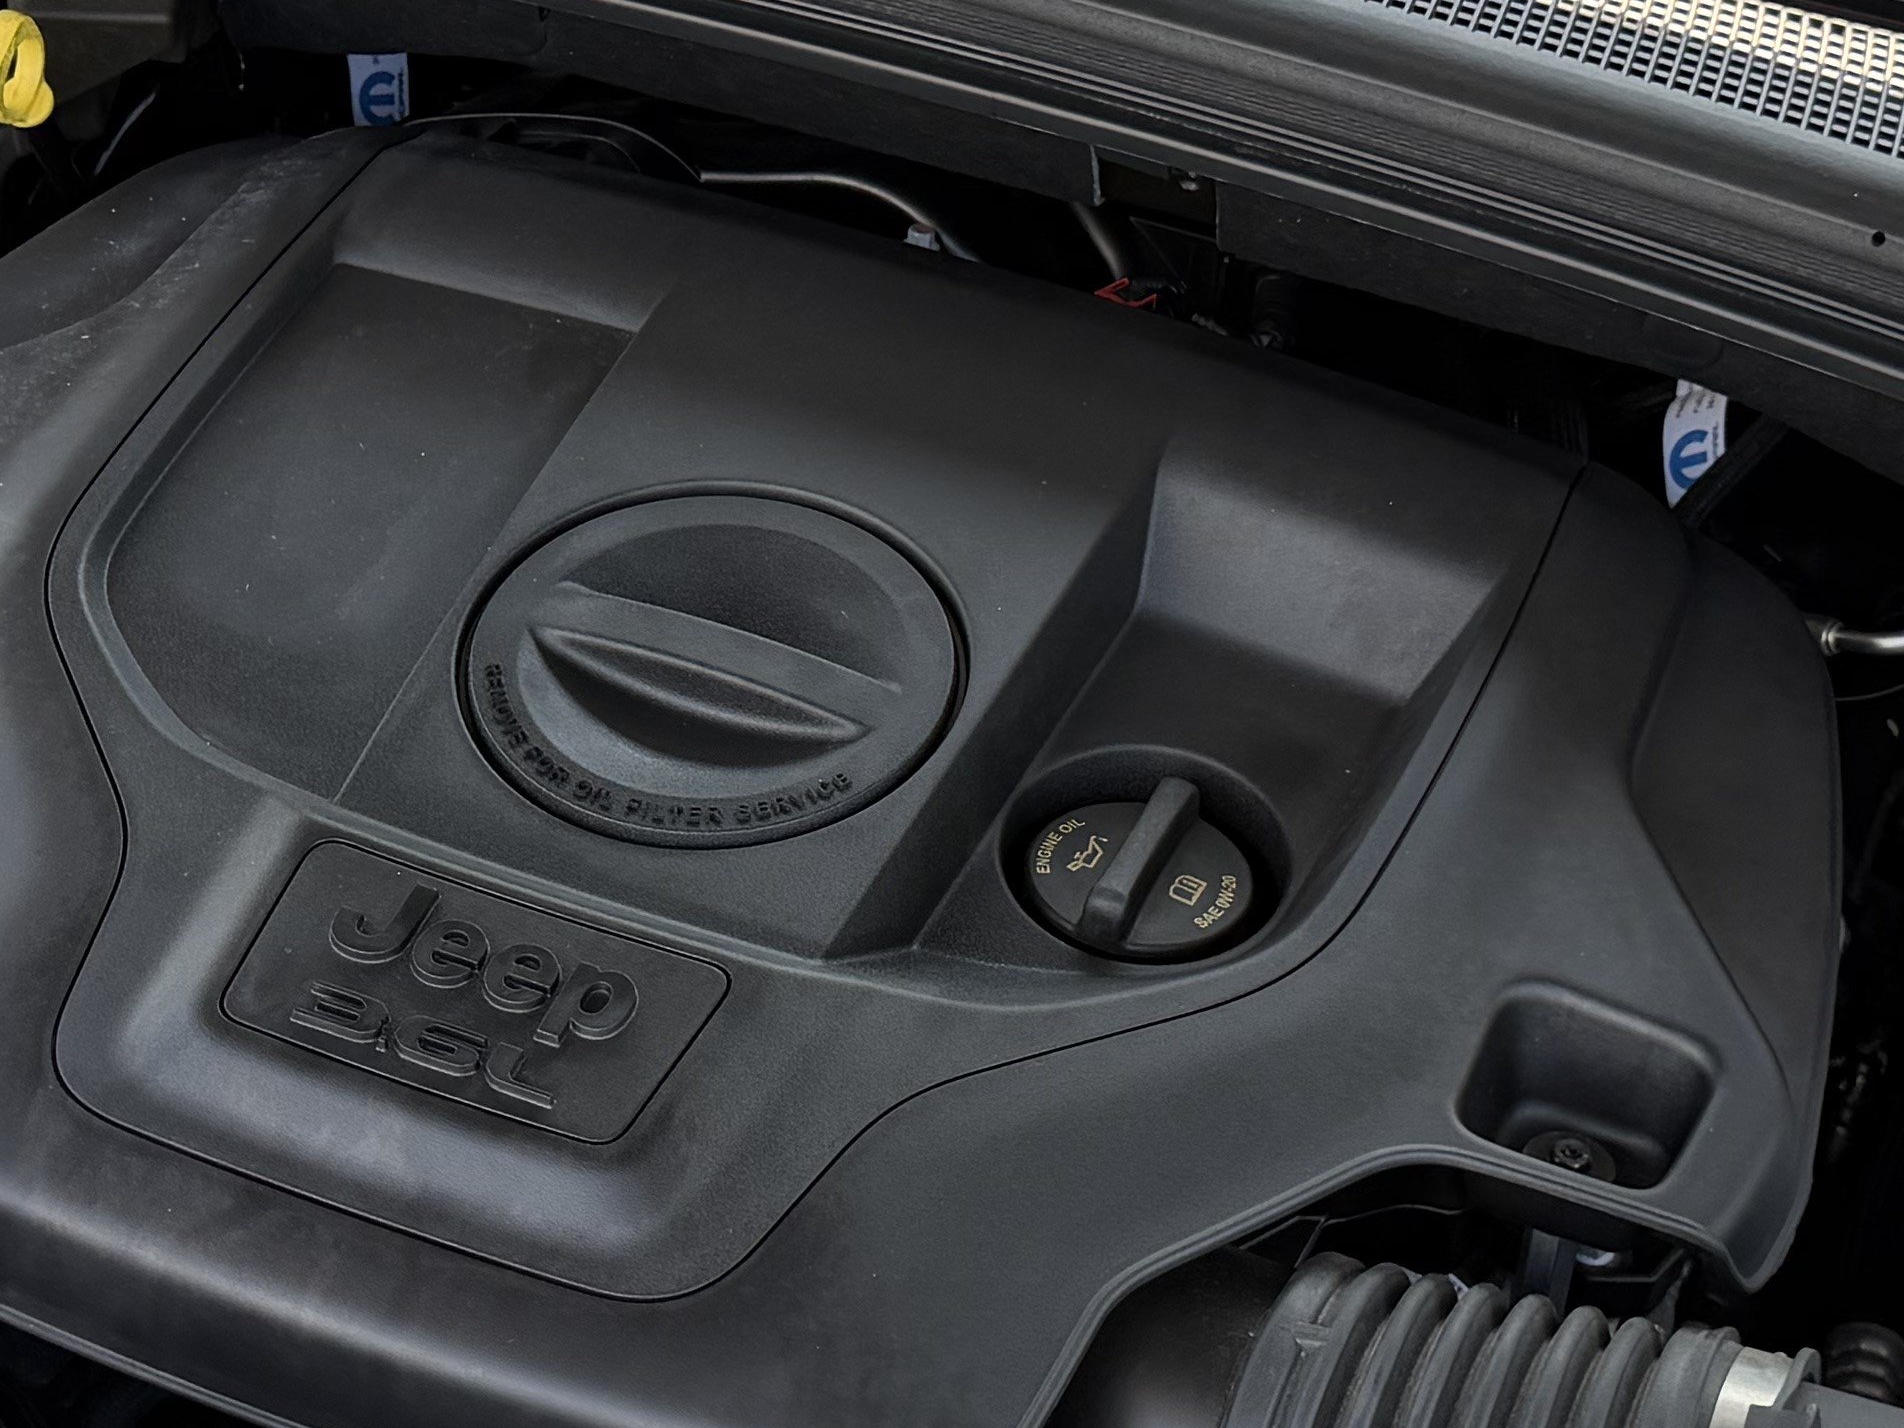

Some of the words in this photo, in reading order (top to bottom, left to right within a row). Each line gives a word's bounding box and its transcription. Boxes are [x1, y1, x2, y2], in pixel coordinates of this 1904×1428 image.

[624, 796, 723, 828] FILTER
[735, 772, 854, 825] SERVICE
[1036, 830, 1064, 875] ENGINE
[1058, 818, 1087, 836] OIL
[1193, 904, 1226, 930] SAE
[328, 882, 640, 1049] Jeep
[289, 980, 557, 1111] 3.6L
